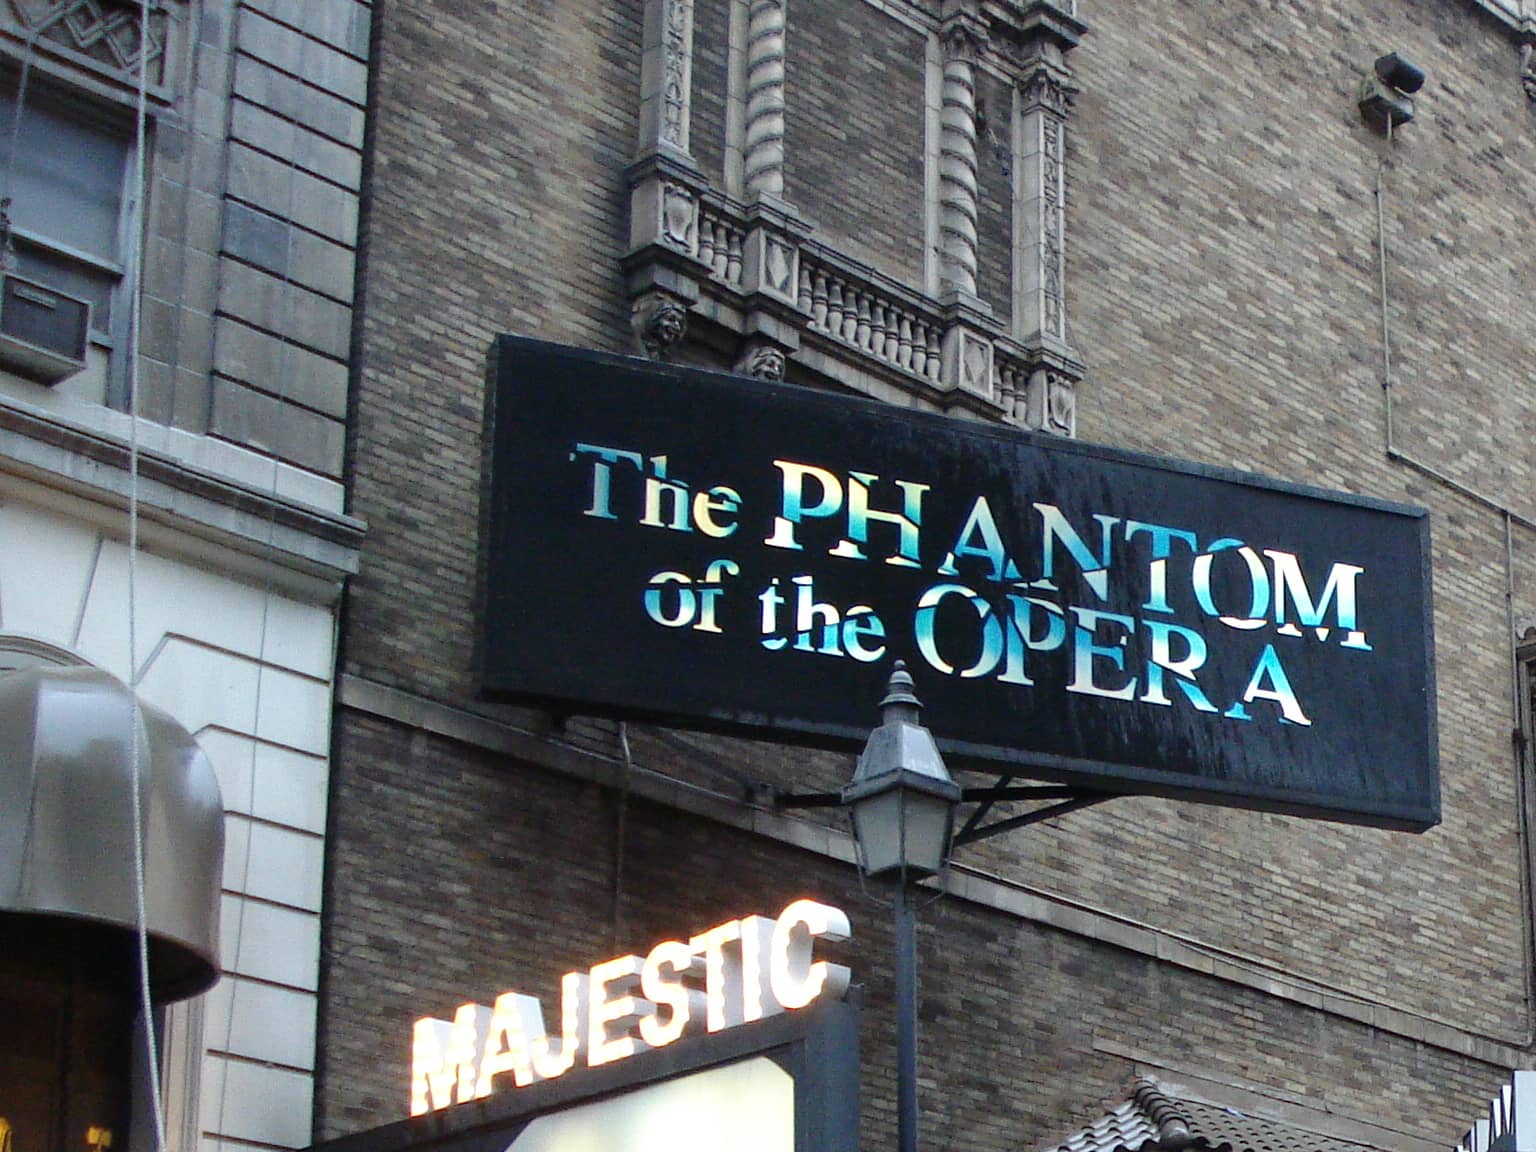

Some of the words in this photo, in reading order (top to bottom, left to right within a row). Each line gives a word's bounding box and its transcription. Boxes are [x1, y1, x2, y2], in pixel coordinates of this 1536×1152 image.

[569, 442, 741, 539] The
[763, 459, 1373, 651] PHANTOM
[643, 558, 739, 634] of
[758, 575, 887, 664] the
[915, 582, 1312, 726] OPERA
[410, 899, 851, 1117] MAJESTIC
